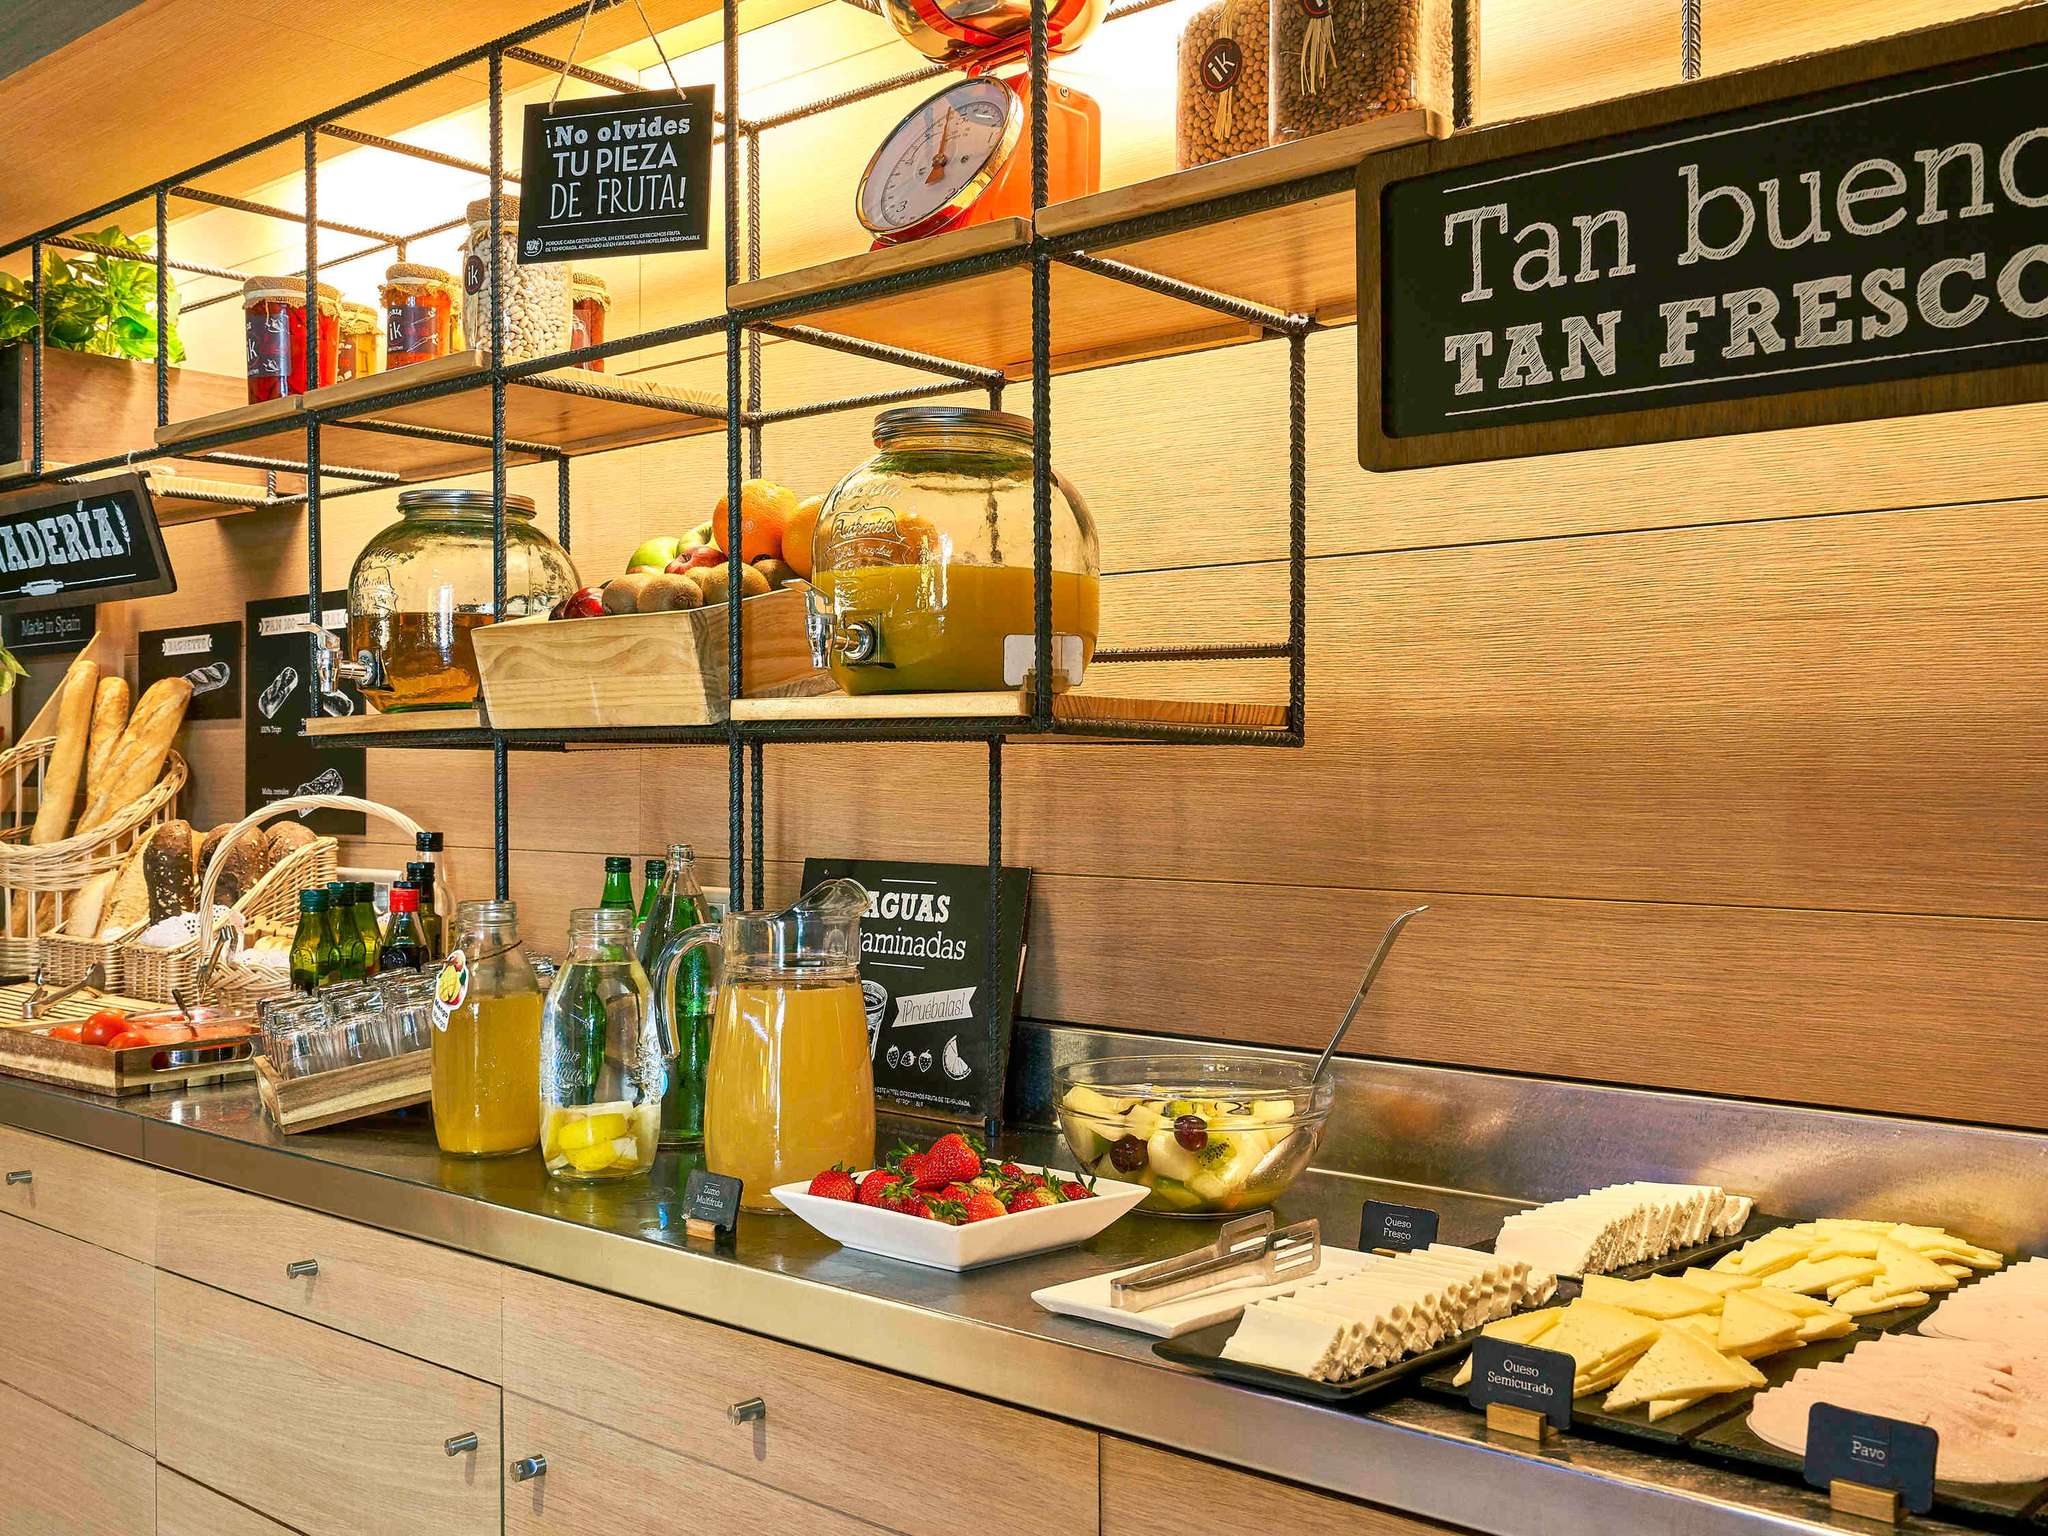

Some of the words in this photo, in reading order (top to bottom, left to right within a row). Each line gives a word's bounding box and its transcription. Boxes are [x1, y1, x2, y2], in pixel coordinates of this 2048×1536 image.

[1208, 52, 1235, 82] ik
[597, 116, 691, 142] olvides
[553, 150, 589, 178] TU
[596, 141, 678, 174] PIEZA
[550, 182, 582, 219] DE
[597, 173, 687, 215] FRUTA!
[1444, 203, 1636, 302] Tan
[468, 265, 479, 286] ik
[389, 321, 402, 341] ik
[1444, 310, 1622, 396] TAN
[1659, 244, 2048, 367] FRESCO
[21, 619, 45, 637] Made
[45, 617, 54, 633] in
[56, 614, 81, 637] Spain
[862, 891, 951, 923] AGUAS
[860, 927, 967, 961] aminadas
[902, 992, 966, 1023] ¡Pruébalas!
[1383, 1227, 1412, 1240] Fresco
[1385, 1216, 1412, 1229] Queso
[1503, 1359, 1540, 1377] Queso
[1487, 1371, 1554, 1396] Semicurado
[1851, 1440, 1886, 1460] Pavo
